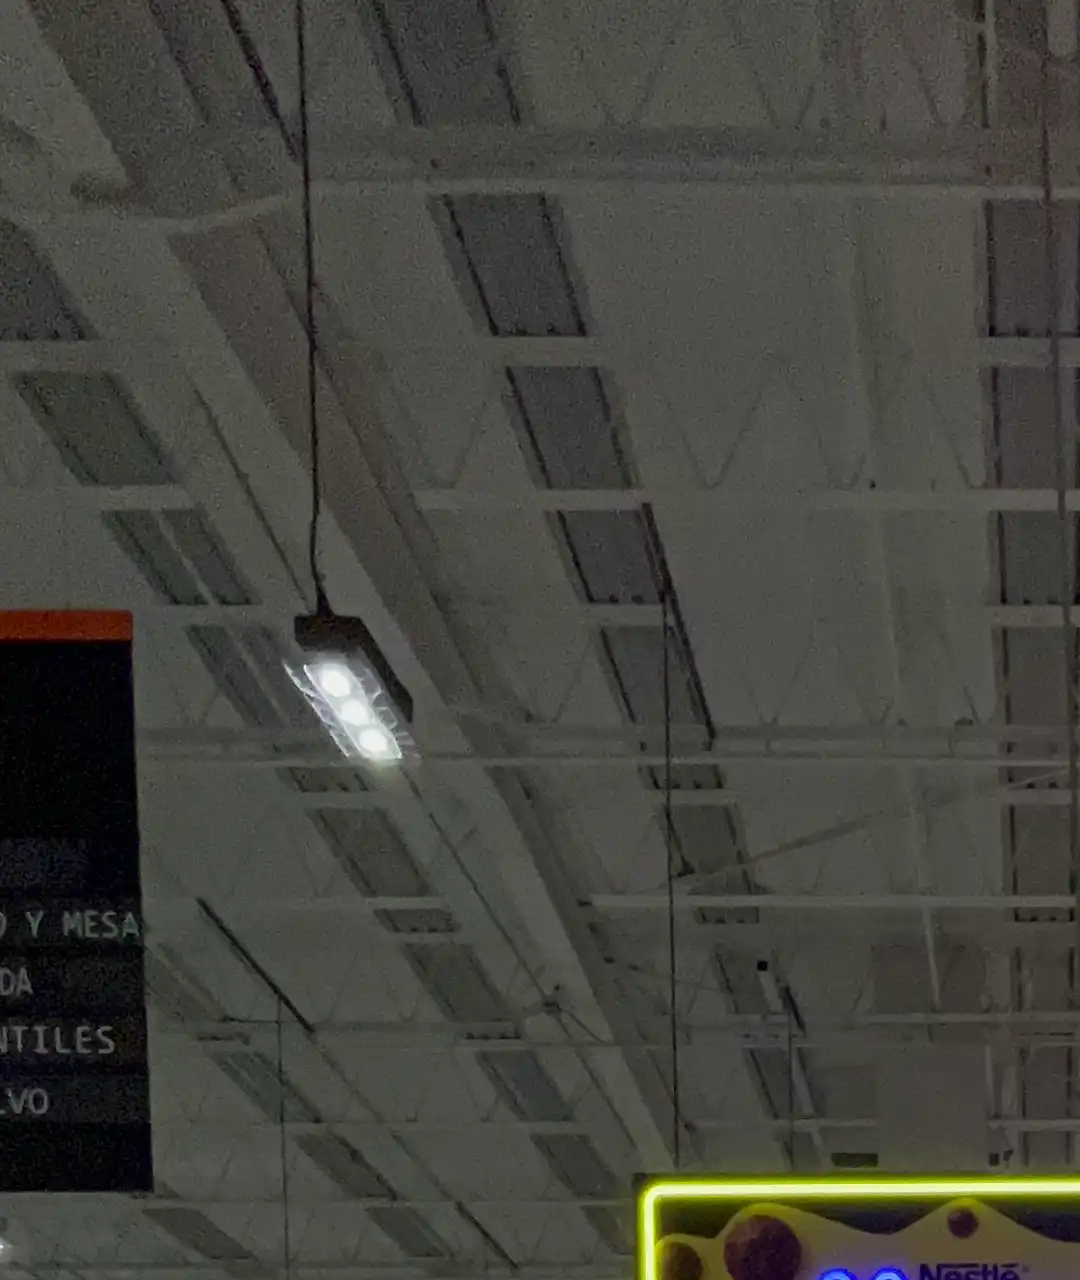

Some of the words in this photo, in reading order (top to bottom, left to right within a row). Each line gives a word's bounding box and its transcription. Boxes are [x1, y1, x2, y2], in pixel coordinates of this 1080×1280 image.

[26, 909, 44, 938] Y
[61, 909, 140, 939] MESA
[0, 1087, 49, 1115] VO
